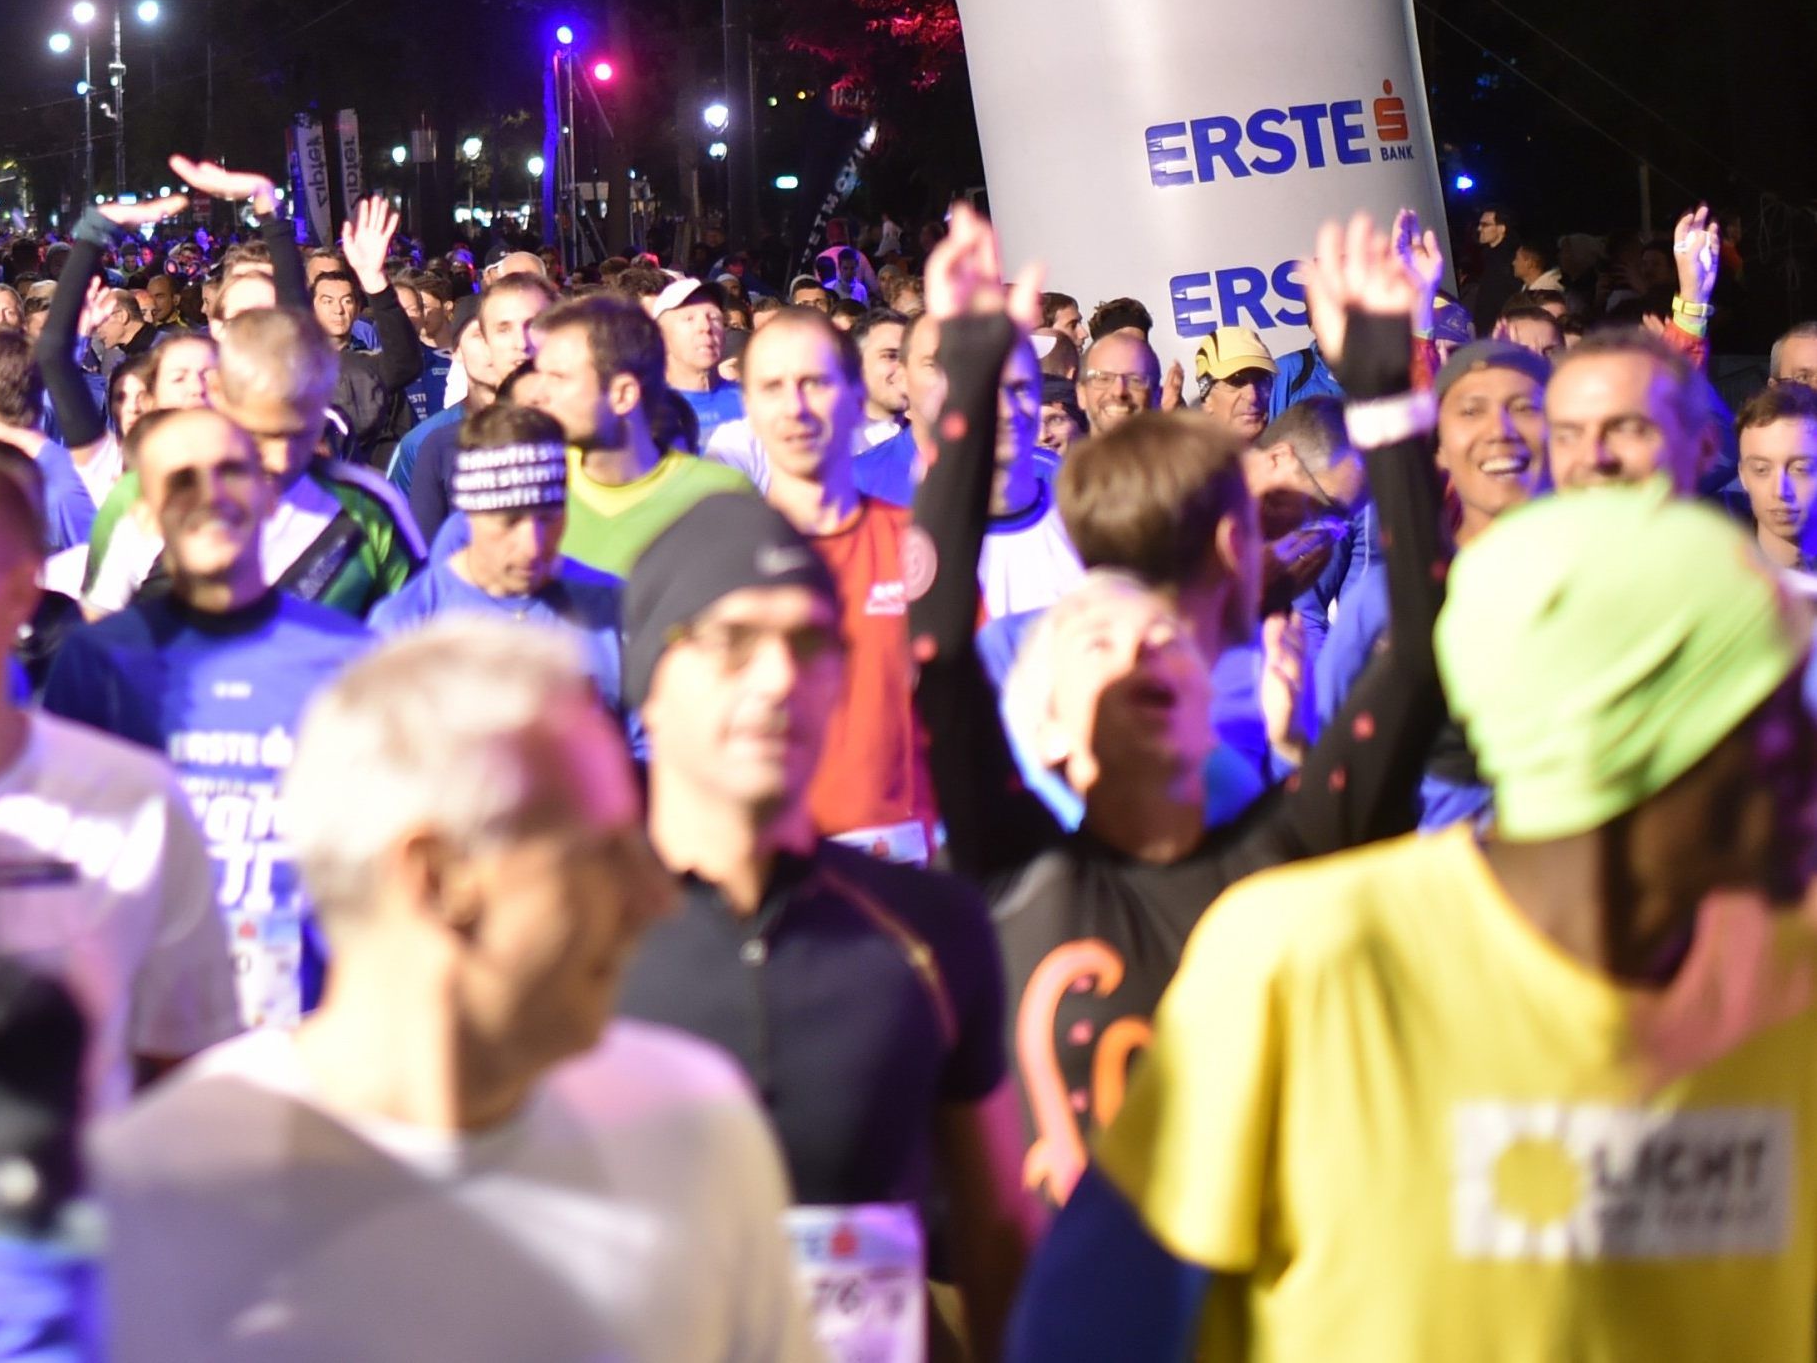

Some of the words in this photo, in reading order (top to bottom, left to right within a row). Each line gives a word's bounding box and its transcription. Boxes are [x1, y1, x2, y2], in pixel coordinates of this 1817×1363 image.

[1144, 100, 1371, 188] ERSTE
[1380, 145, 1414, 162] BANK
[1169, 259, 1310, 338] ERS
